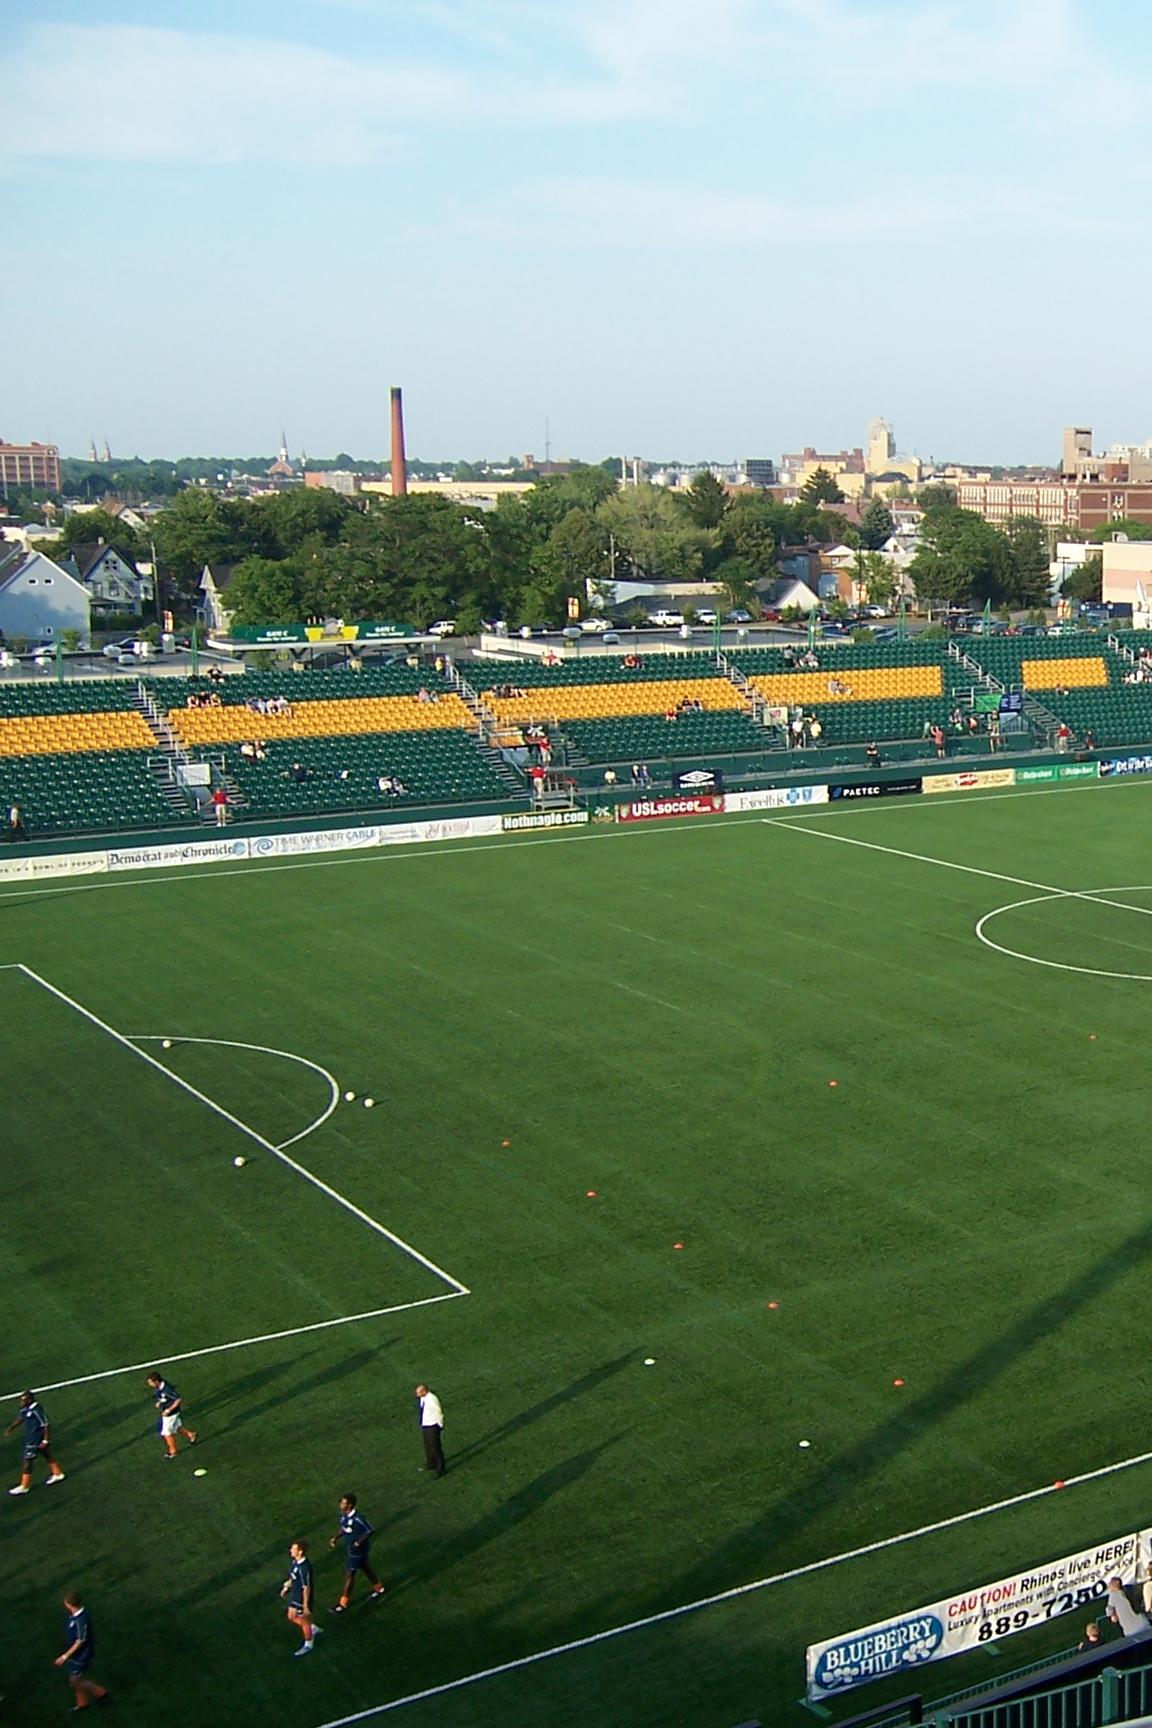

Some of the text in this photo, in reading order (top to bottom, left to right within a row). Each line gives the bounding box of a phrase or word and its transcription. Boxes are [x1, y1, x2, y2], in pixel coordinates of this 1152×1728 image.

[843, 787, 880, 796] PAETEC
[948, 1582, 1017, 1617] CAUTION!
[1020, 1568, 1065, 1593] Rhinos
[1068, 1558, 1091, 1575] live
[978, 1580, 1108, 1641] 889-7250
[826, 1618, 933, 1670] BLUEBERRY
[860, 1648, 902, 1675] HILL
